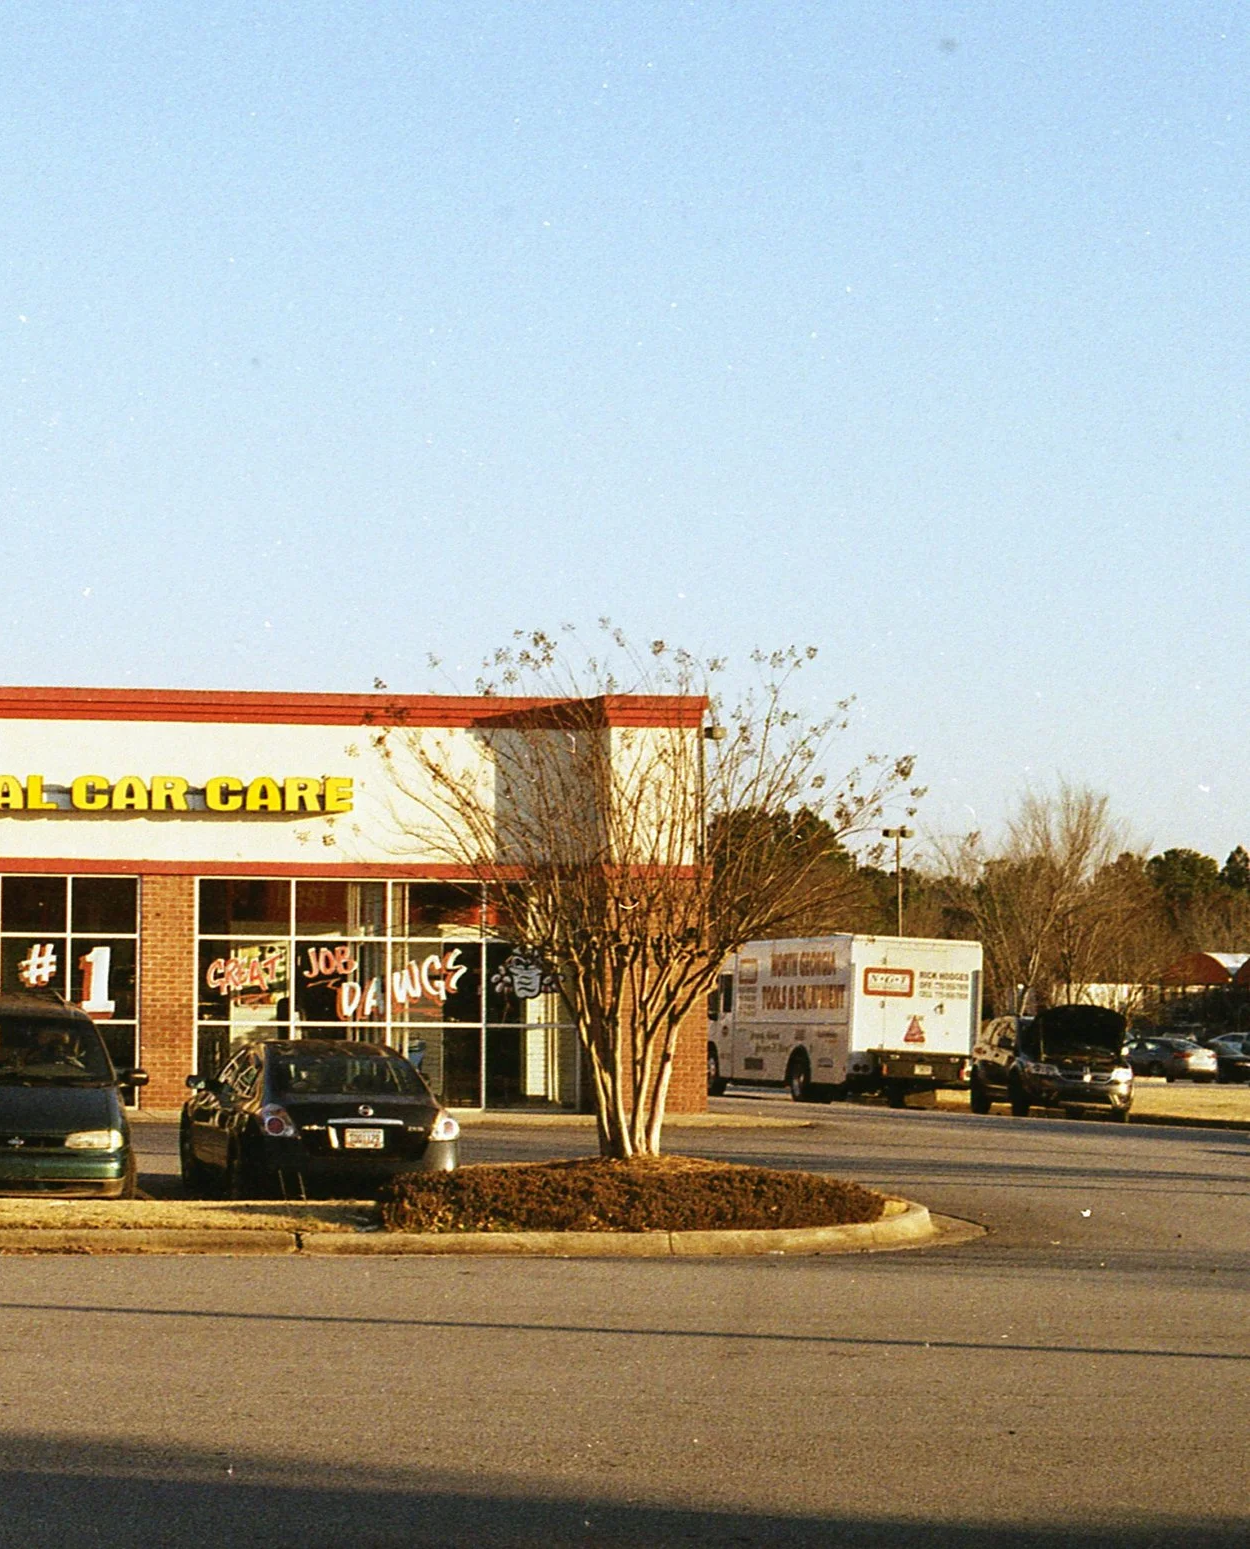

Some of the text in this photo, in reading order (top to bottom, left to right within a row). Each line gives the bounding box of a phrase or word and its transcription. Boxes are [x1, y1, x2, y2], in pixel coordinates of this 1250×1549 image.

[71, 775, 195, 811] CAR
[205, 776, 354, 812] CARE
[207, 945, 359, 995] GREAT JOB
[336, 947, 468, 1022] DAWGS
